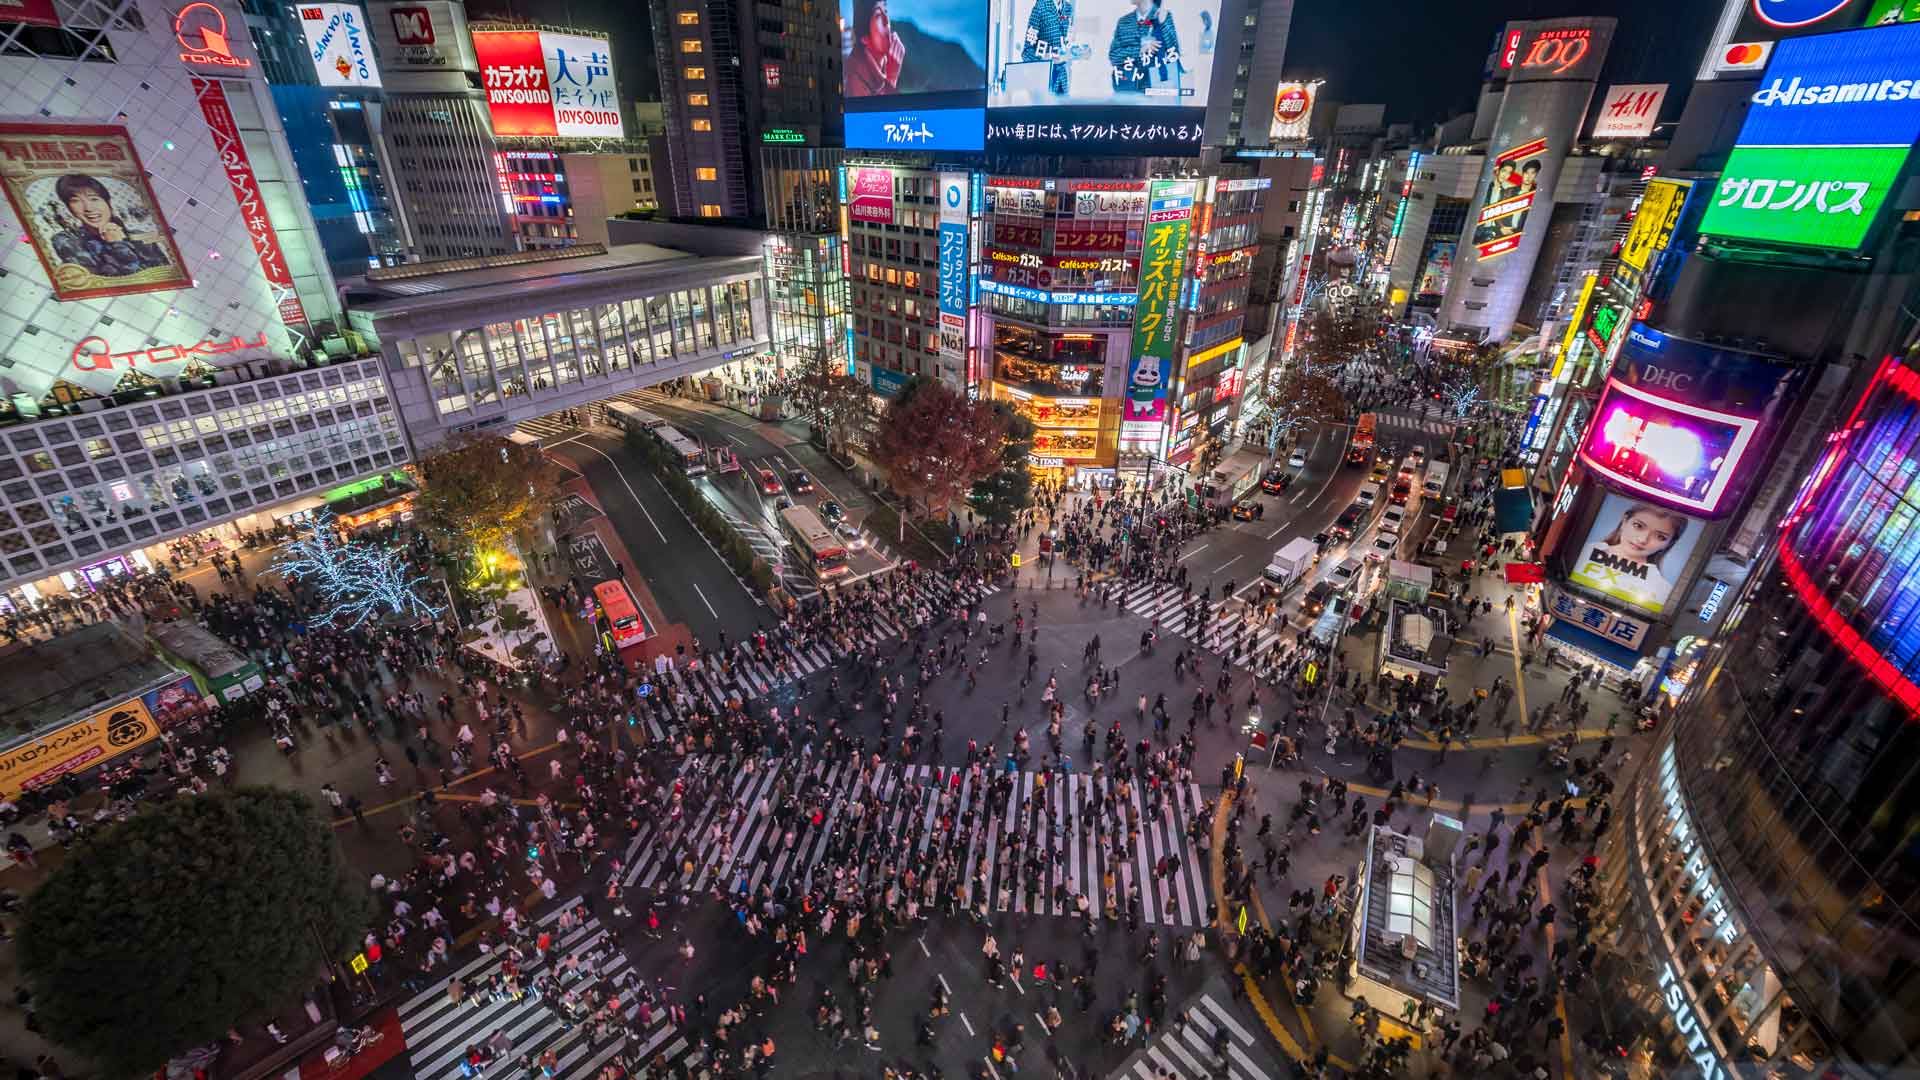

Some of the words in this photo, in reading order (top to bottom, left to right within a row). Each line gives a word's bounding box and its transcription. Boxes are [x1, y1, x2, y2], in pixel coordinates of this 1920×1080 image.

[314, 14, 341, 62] SANKYO
[342, 12, 369, 79] SANKYO
[1541, 29, 1591, 39] SHIBUYA
[179, 53, 251, 67] TOKYU
[547, 47, 609, 87] 大声
[1520, 37, 1589, 74] 109
[484, 64, 544, 88] カラオケ
[489, 88, 551, 104] JOYSOUND
[1608, 91, 1659, 117] H&M
[557, 109, 619, 126] JOYSOUND
[883, 122, 934, 144] アルフォート
[1100, 197, 1145, 213] しゃぶ葉
[1718, 178, 1871, 216] サロンパス
[943, 231, 954, 308] アイシティ
[955, 232, 964, 309] コンタクトの
[1020, 253, 1043, 268] ガスト
[1100, 259, 1132, 272] ガスト
[112, 332, 268, 367] TOKYU
[1642, 365, 1693, 391] DHC
[1589, 548, 1648, 580] DMM
